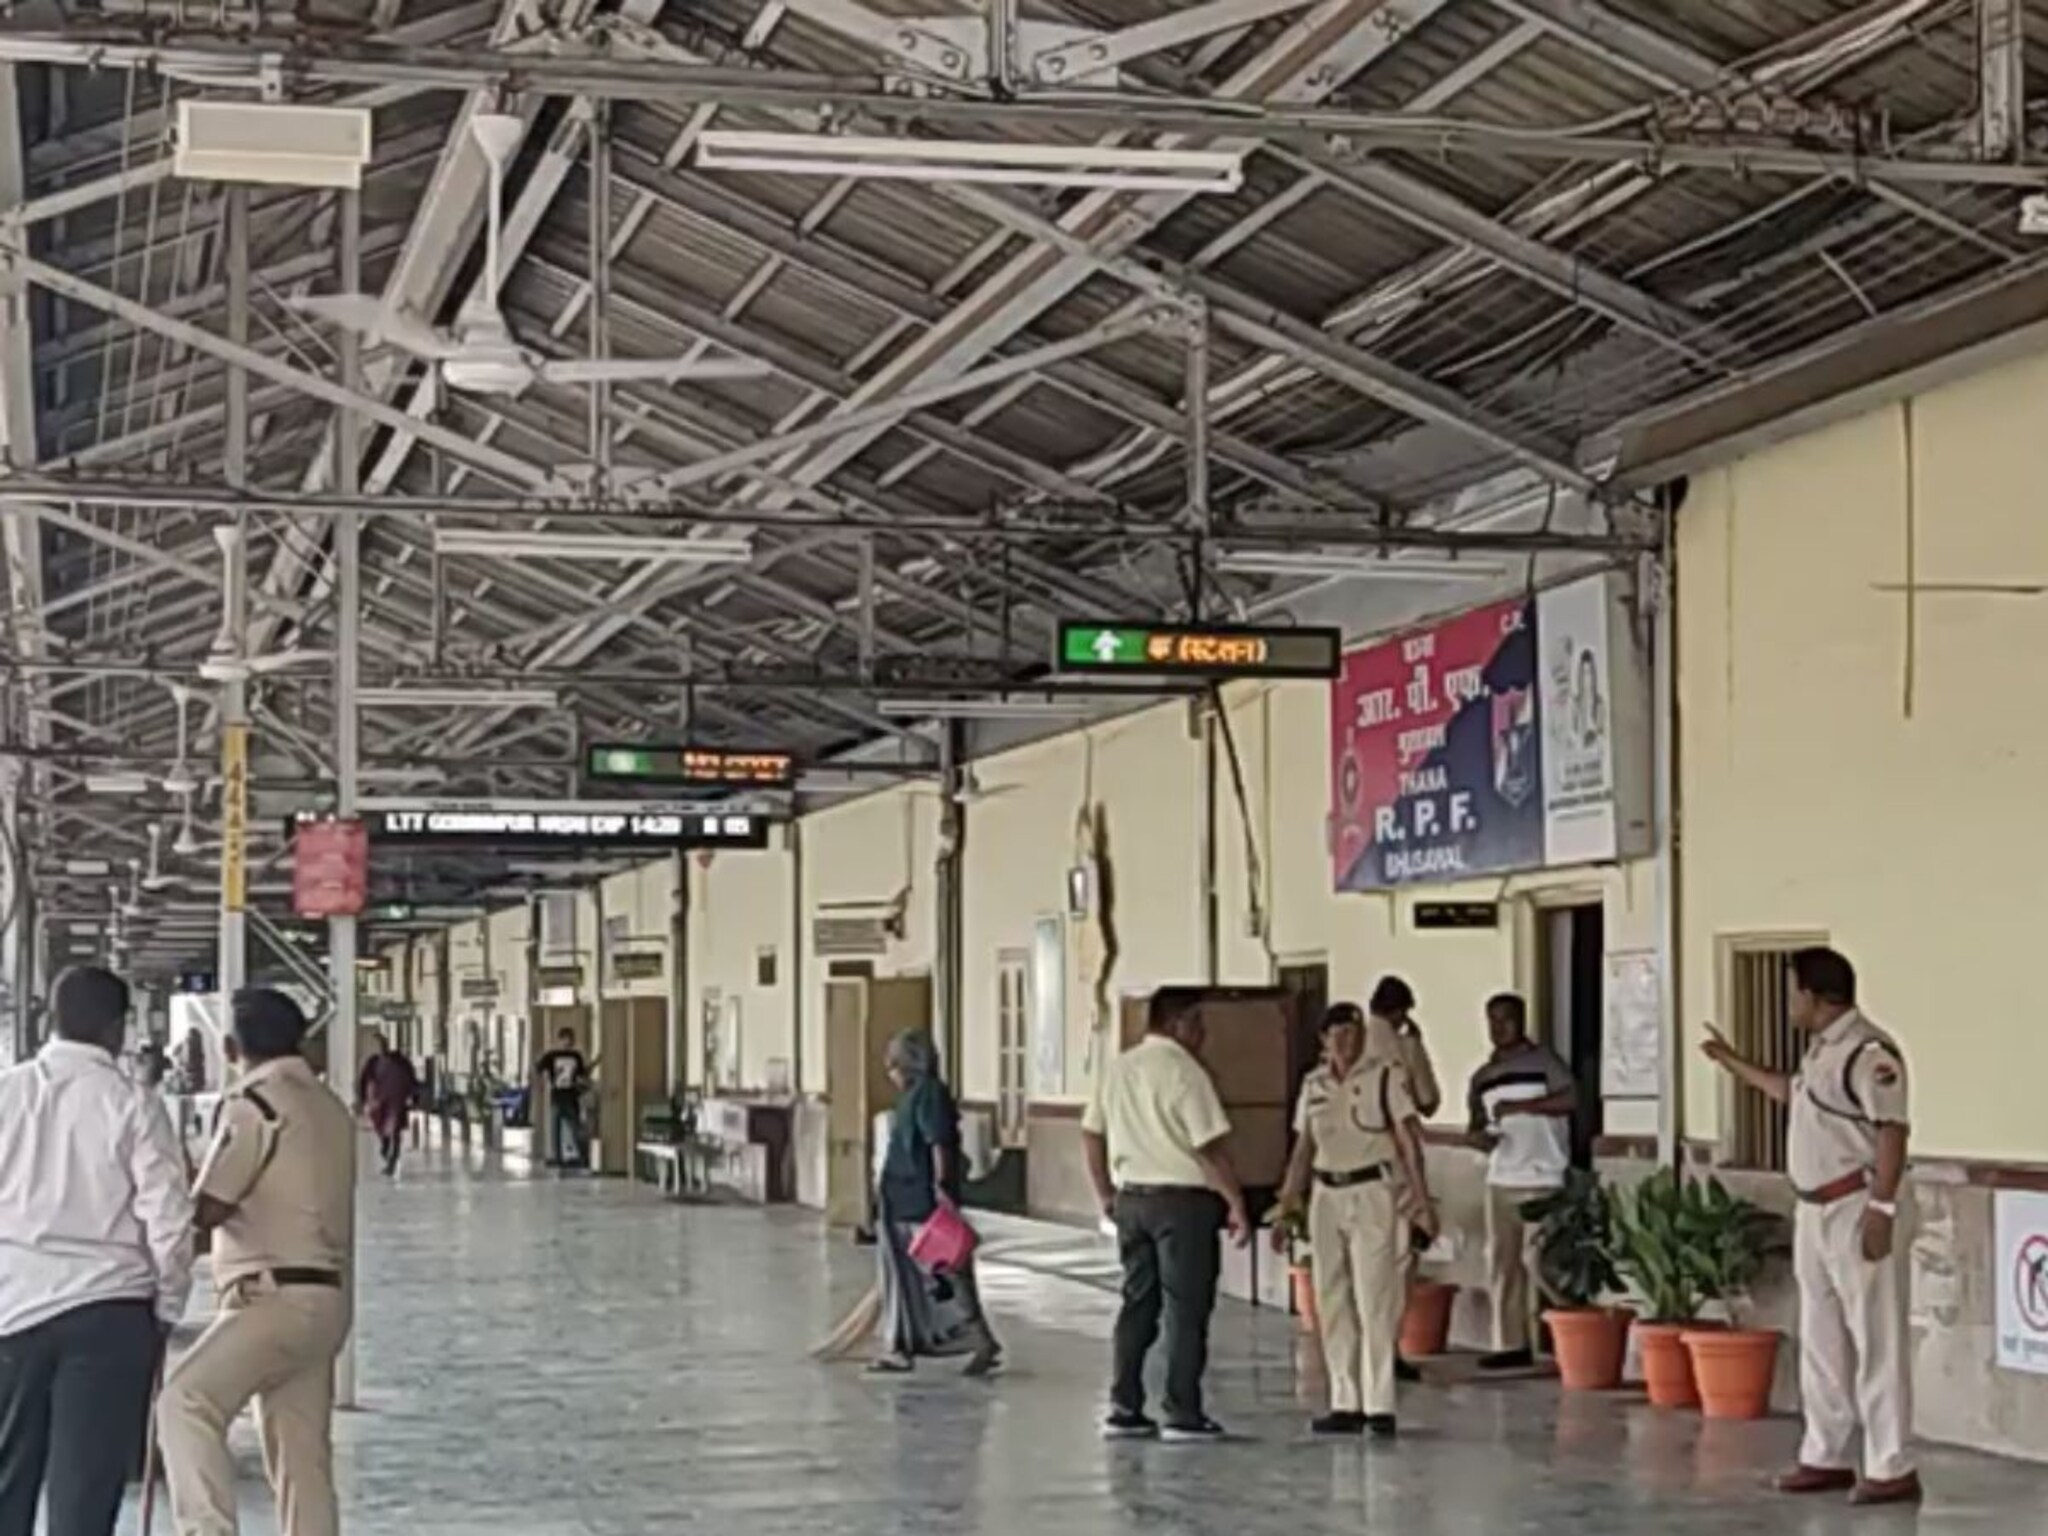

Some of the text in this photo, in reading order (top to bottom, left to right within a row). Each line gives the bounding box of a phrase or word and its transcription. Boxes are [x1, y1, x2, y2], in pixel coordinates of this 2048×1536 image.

[1375, 791, 1477, 843] R. P. F.
